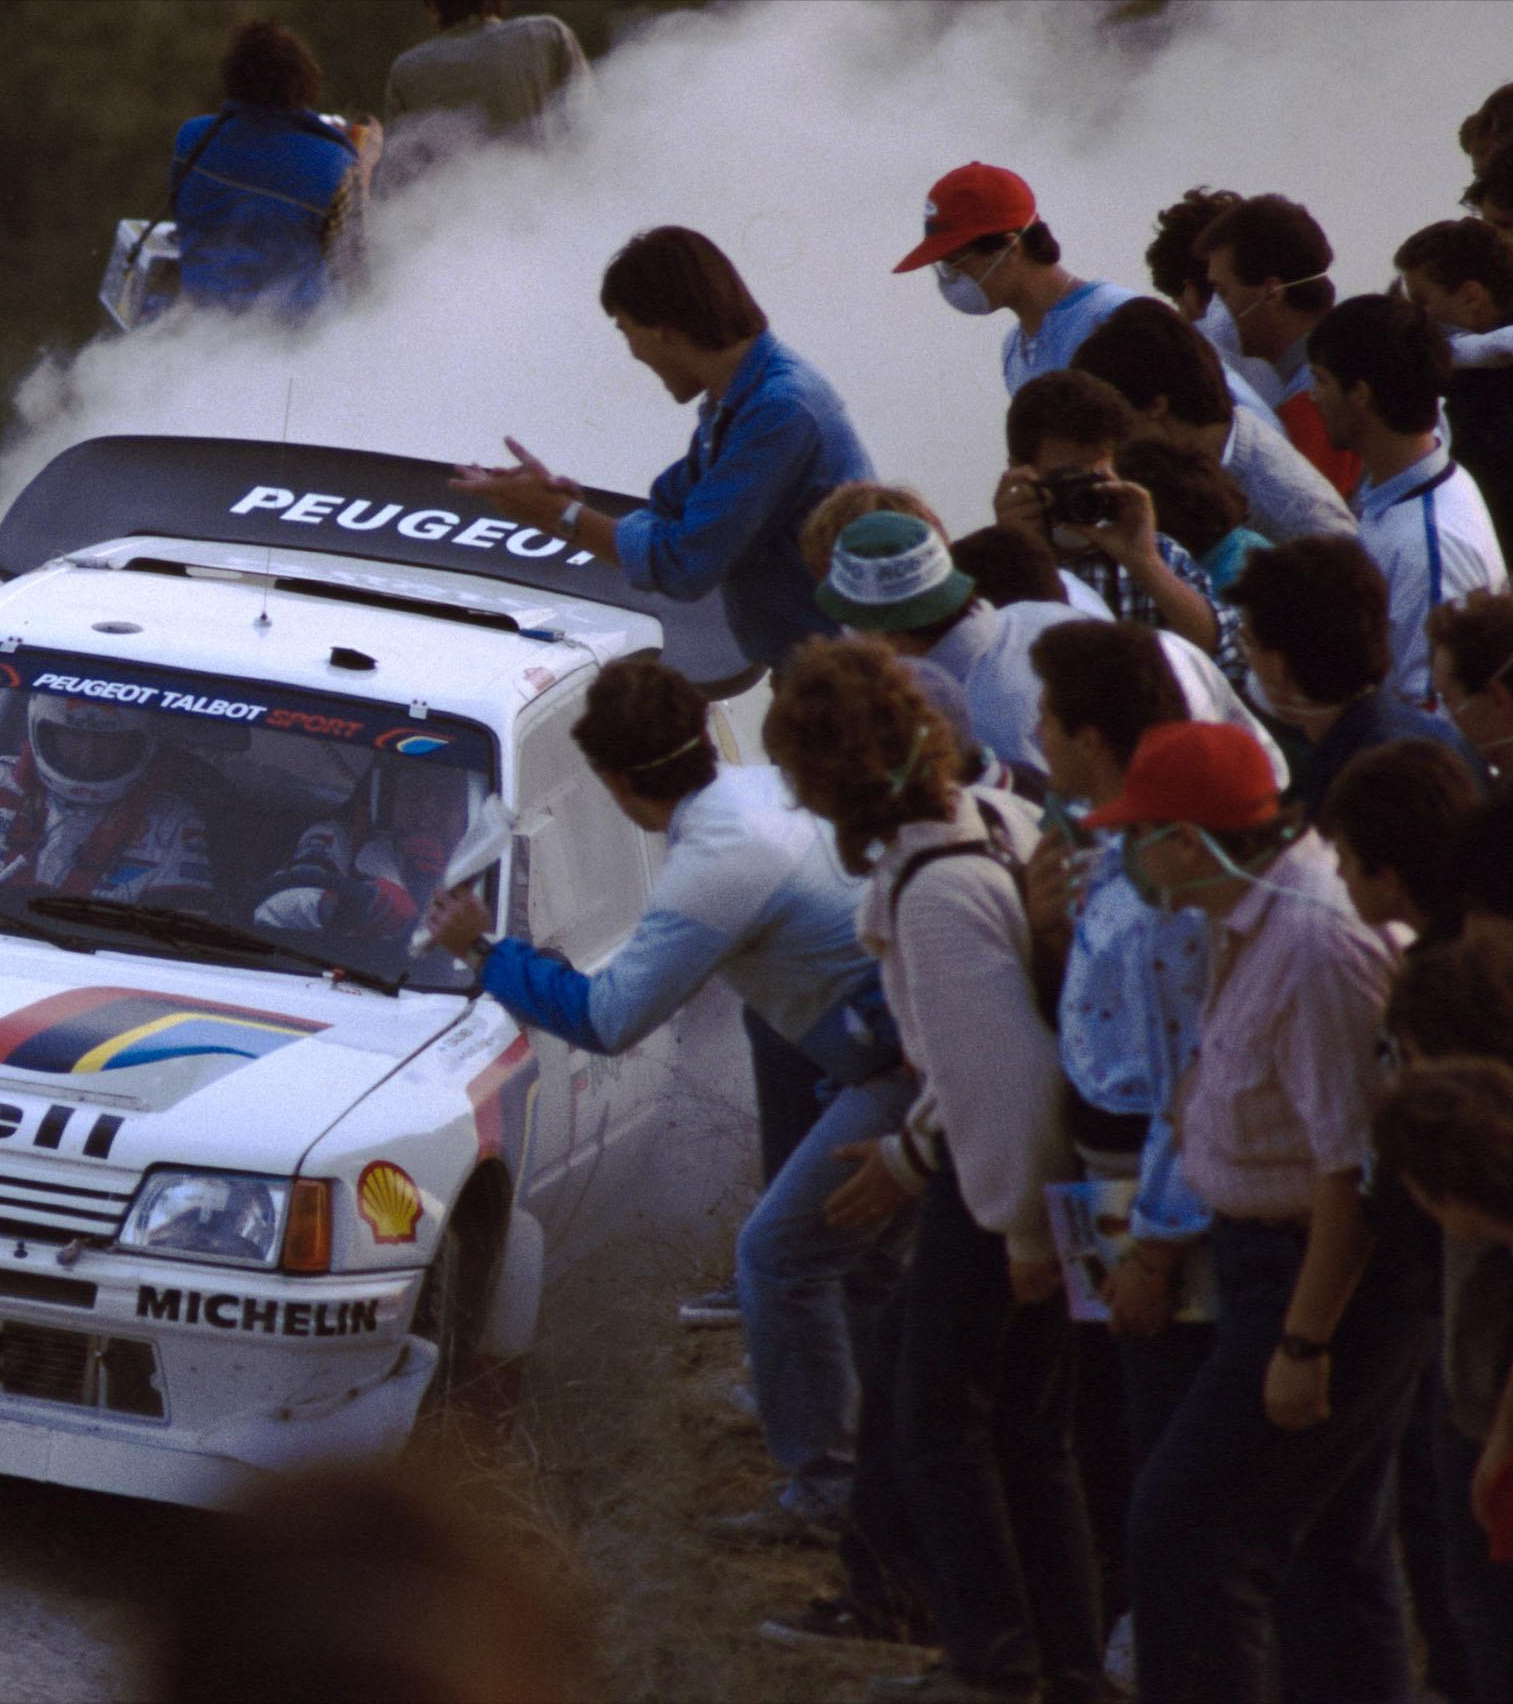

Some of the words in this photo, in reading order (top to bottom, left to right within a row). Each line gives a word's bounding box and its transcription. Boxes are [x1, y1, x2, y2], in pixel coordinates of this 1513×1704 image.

[32, 673, 160, 704] PEUGEOT
[160, 690, 267, 721] TALBOT
[265, 708, 365, 738] SPORT
[136, 1285, 378, 1337] MICHELIN
